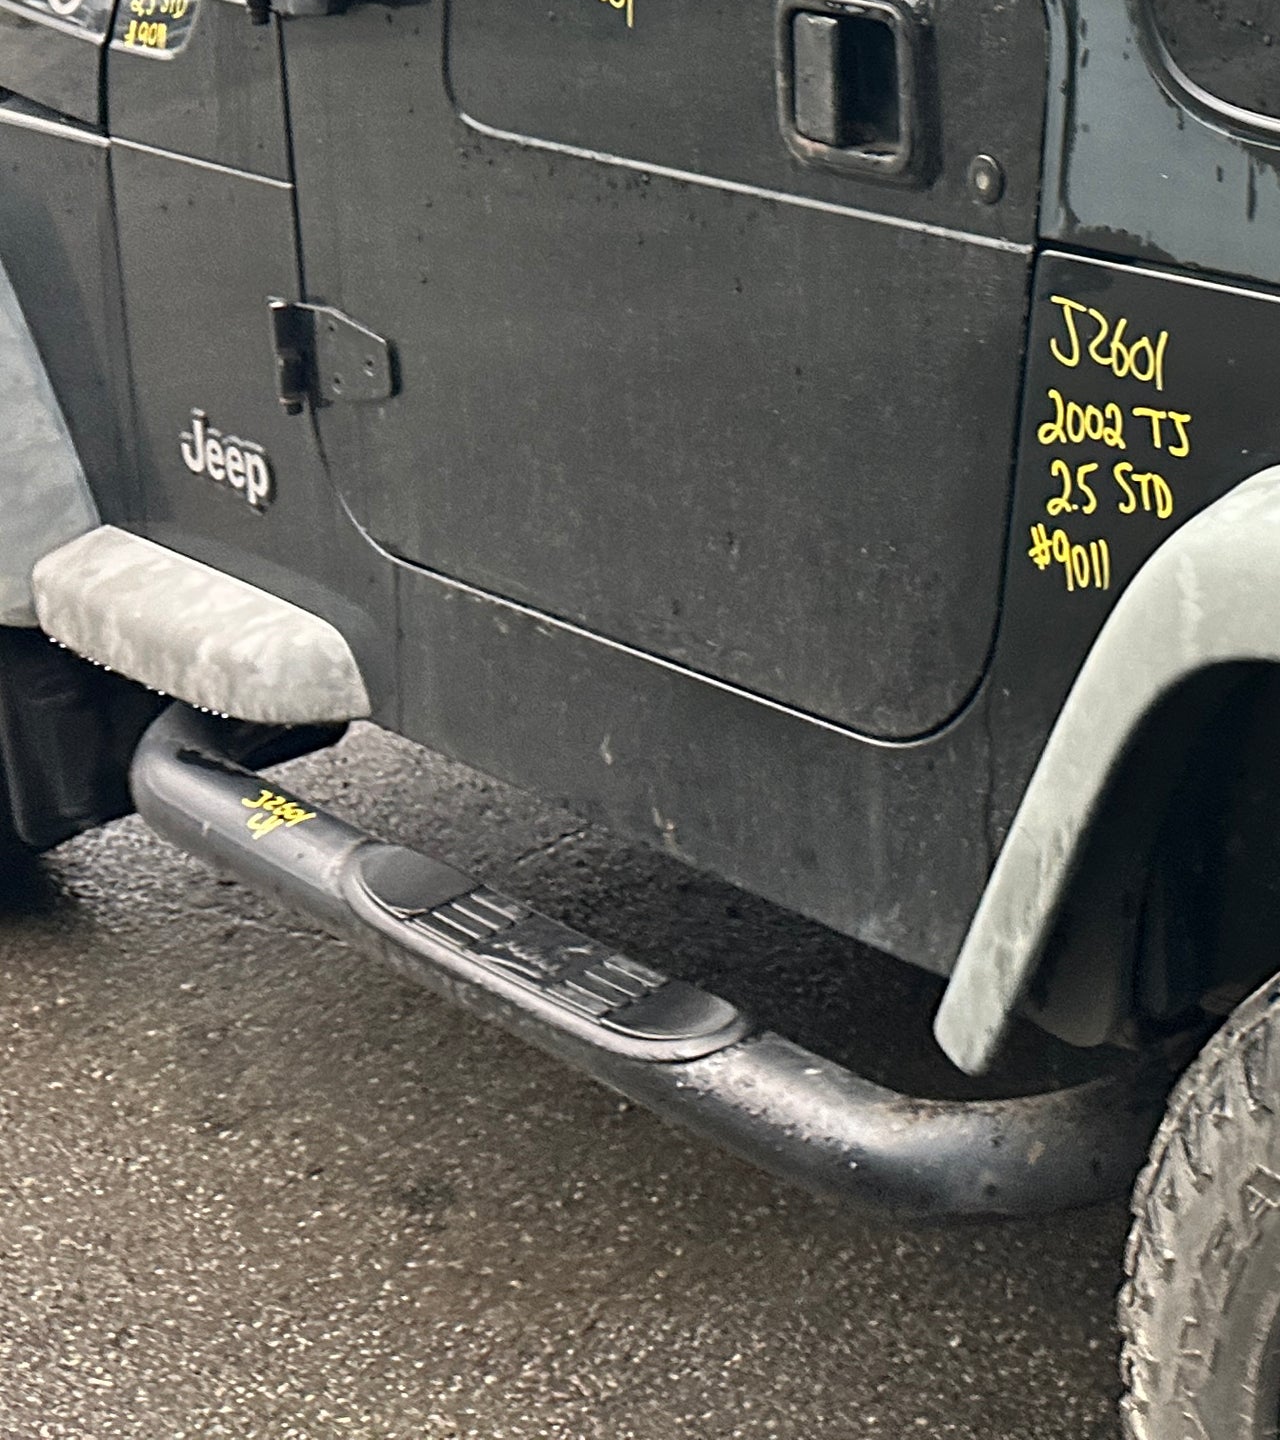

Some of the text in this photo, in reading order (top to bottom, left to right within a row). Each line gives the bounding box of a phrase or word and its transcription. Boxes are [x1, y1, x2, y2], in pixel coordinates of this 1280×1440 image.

[1051, 295, 1168, 390] J2601
[179, 407, 269, 505] Jeep
[1037, 389, 1191, 457] 2002 TJ
[1113, 461, 1173, 518] STD
